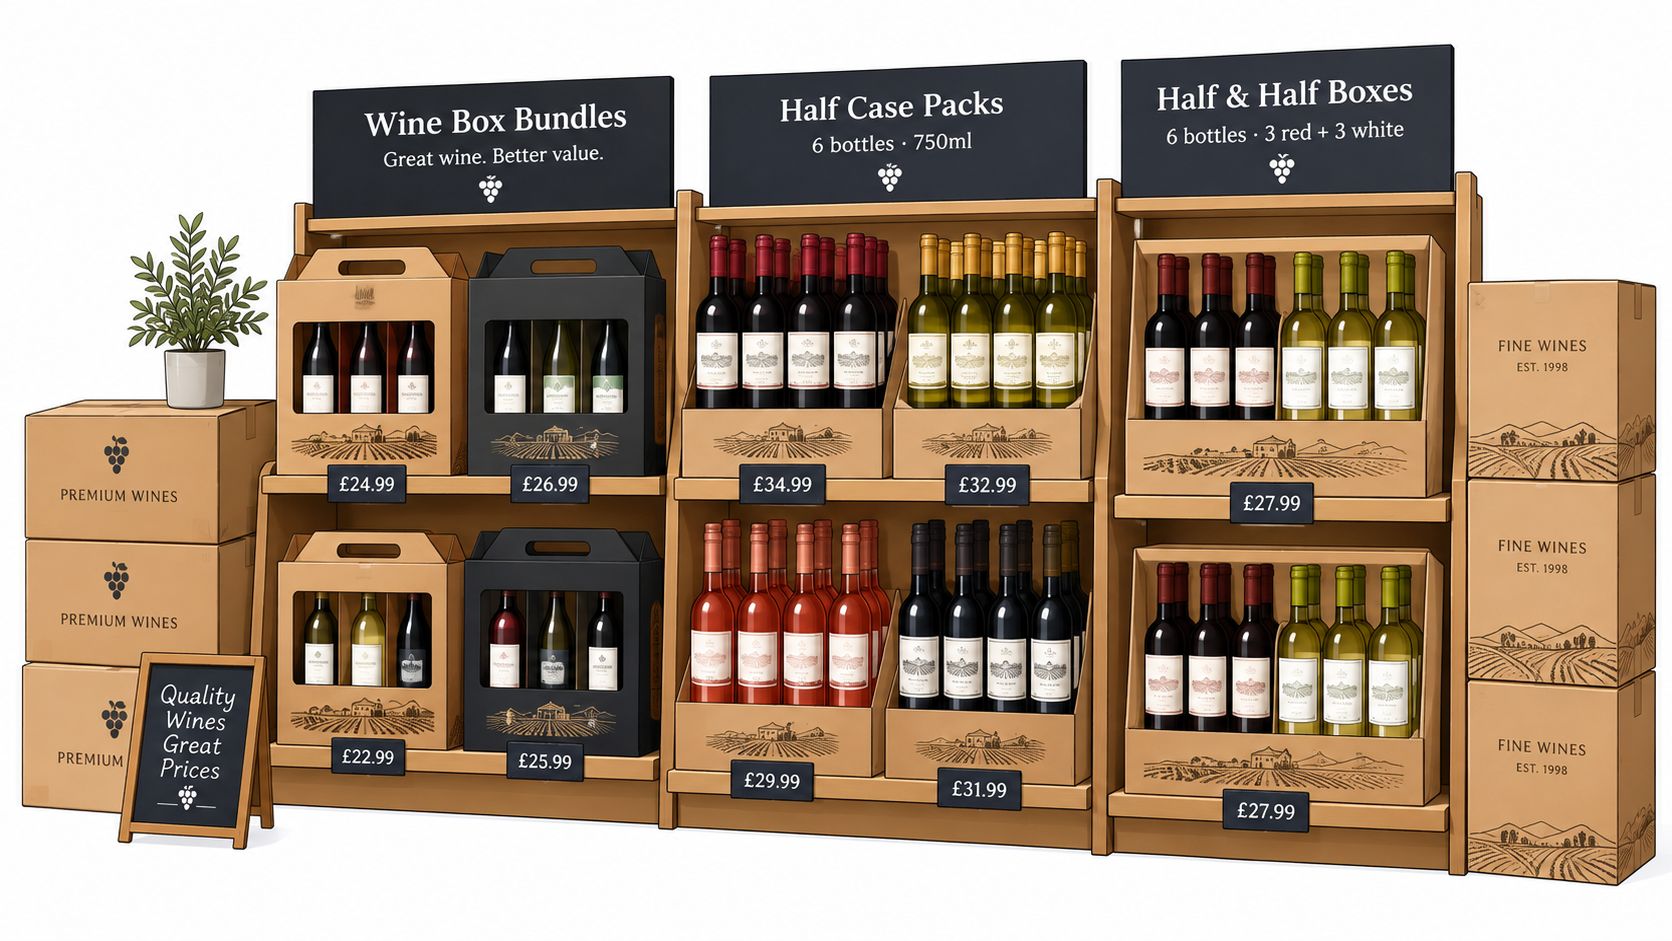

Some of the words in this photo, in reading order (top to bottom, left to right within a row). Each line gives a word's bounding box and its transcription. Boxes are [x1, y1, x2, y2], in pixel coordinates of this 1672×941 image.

[1158, 84, 1219, 111] Half
[1227, 84, 1249, 108] &
[1259, 79, 1321, 107] Half
[1328, 80, 1412, 104] Boxes
[781, 96, 840, 122] Half
[848, 96, 913, 119] Case
[924, 91, 1003, 117] Packs
[364, 111, 441, 136] Wine
[452, 110, 505, 133] Box
[515, 103, 626, 131] Bundles
[1167, 129, 1177, 144] 6
[1184, 126, 1246, 144] bottles
[1265, 125, 1275, 141] 3
[1282, 123, 1311, 141] red
[1335, 123, 1345, 139] 3
[1351, 121, 1404, 138] white
[813, 138, 823, 153] 6
[830, 135, 894, 152] bottles
[914, 132, 972, 150] 750ml
[384, 152, 433, 167] Great
[439, 149, 486, 165] wine.
[493, 148, 547, 163] Better
[552, 145, 603, 161] value.
[1499, 340, 1531, 351] FINE
[1538, 340, 1586, 352] WINES
[1517, 362, 1539, 372] EST.
[1544, 362, 1568, 372] 1998
[339, 476, 394, 492] £24.99
[523, 476, 578, 492] £26.99
[754, 476, 811, 492] £34.99
[959, 477, 1016, 493] £32.99
[61, 489, 125, 502] PREMIUM
[132, 490, 177, 502] WINES
[1244, 495, 1300, 511] £27.99
[1499, 540, 1531, 552] FINE
[1538, 541, 1586, 554] WINES
[1517, 563, 1539, 572] EST.
[1544, 564, 1568, 574] 1998
[62, 613, 125, 627] PREMIUM
[132, 616, 177, 629] WINES
[161, 684, 235, 712] Quality
[168, 710, 226, 731] Wines
[164, 734, 221, 755] Great
[1499, 739, 1531, 752] FINE
[1537, 742, 1585, 756] WINES
[58, 752, 123, 767] PREMIUM
[342, 749, 394, 764] £22.99
[519, 753, 571, 769] £25.99
[161, 758, 219, 779] Prices
[1517, 763, 1538, 773] EST.
[1544, 765, 1567, 775] 1998
[744, 772, 800, 789] £29.99
[952, 781, 1006, 798] £31.99
[1238, 802, 1295, 820] £27.99
